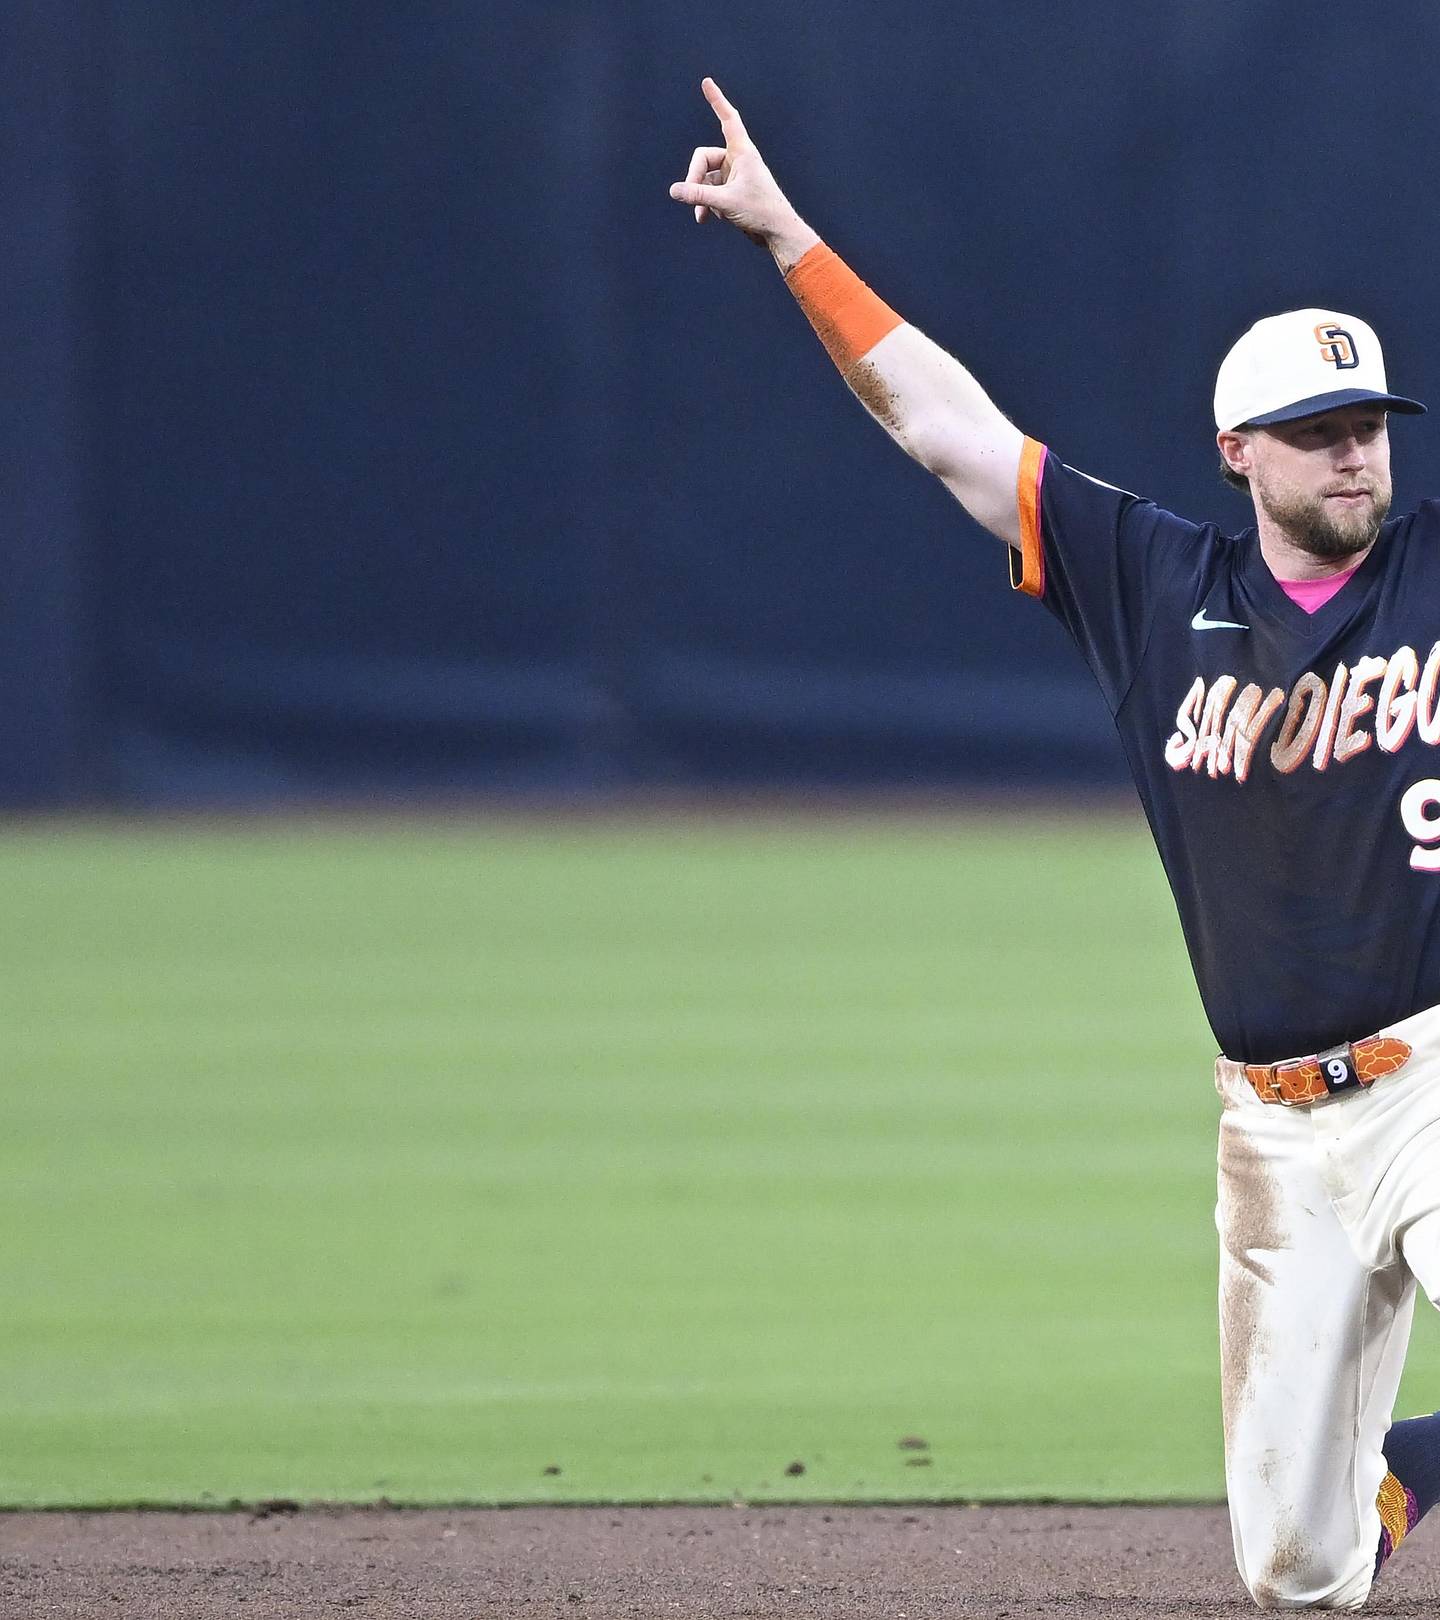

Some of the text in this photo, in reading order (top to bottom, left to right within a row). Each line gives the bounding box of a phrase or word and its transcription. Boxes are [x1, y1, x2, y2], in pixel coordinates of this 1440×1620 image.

[1314, 322, 1360, 370] SD
[1165, 674, 1285, 784] SAN
[1327, 1058, 1348, 1084] 9
